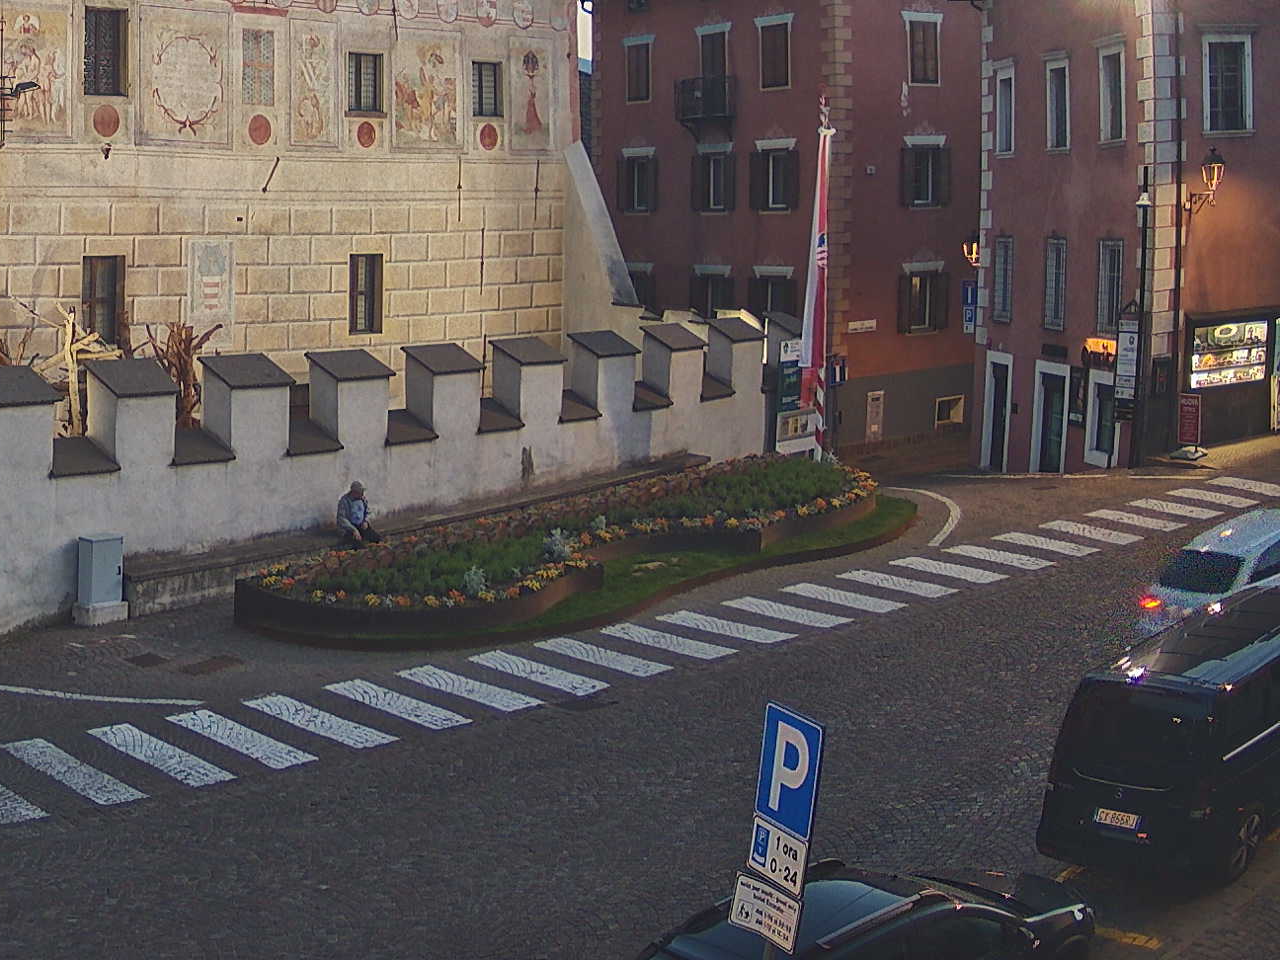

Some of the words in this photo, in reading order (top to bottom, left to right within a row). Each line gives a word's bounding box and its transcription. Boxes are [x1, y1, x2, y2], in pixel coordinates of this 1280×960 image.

[768, 720, 810, 812] P
[776, 835, 781, 850] 1
[782, 844, 798, 862] ora
